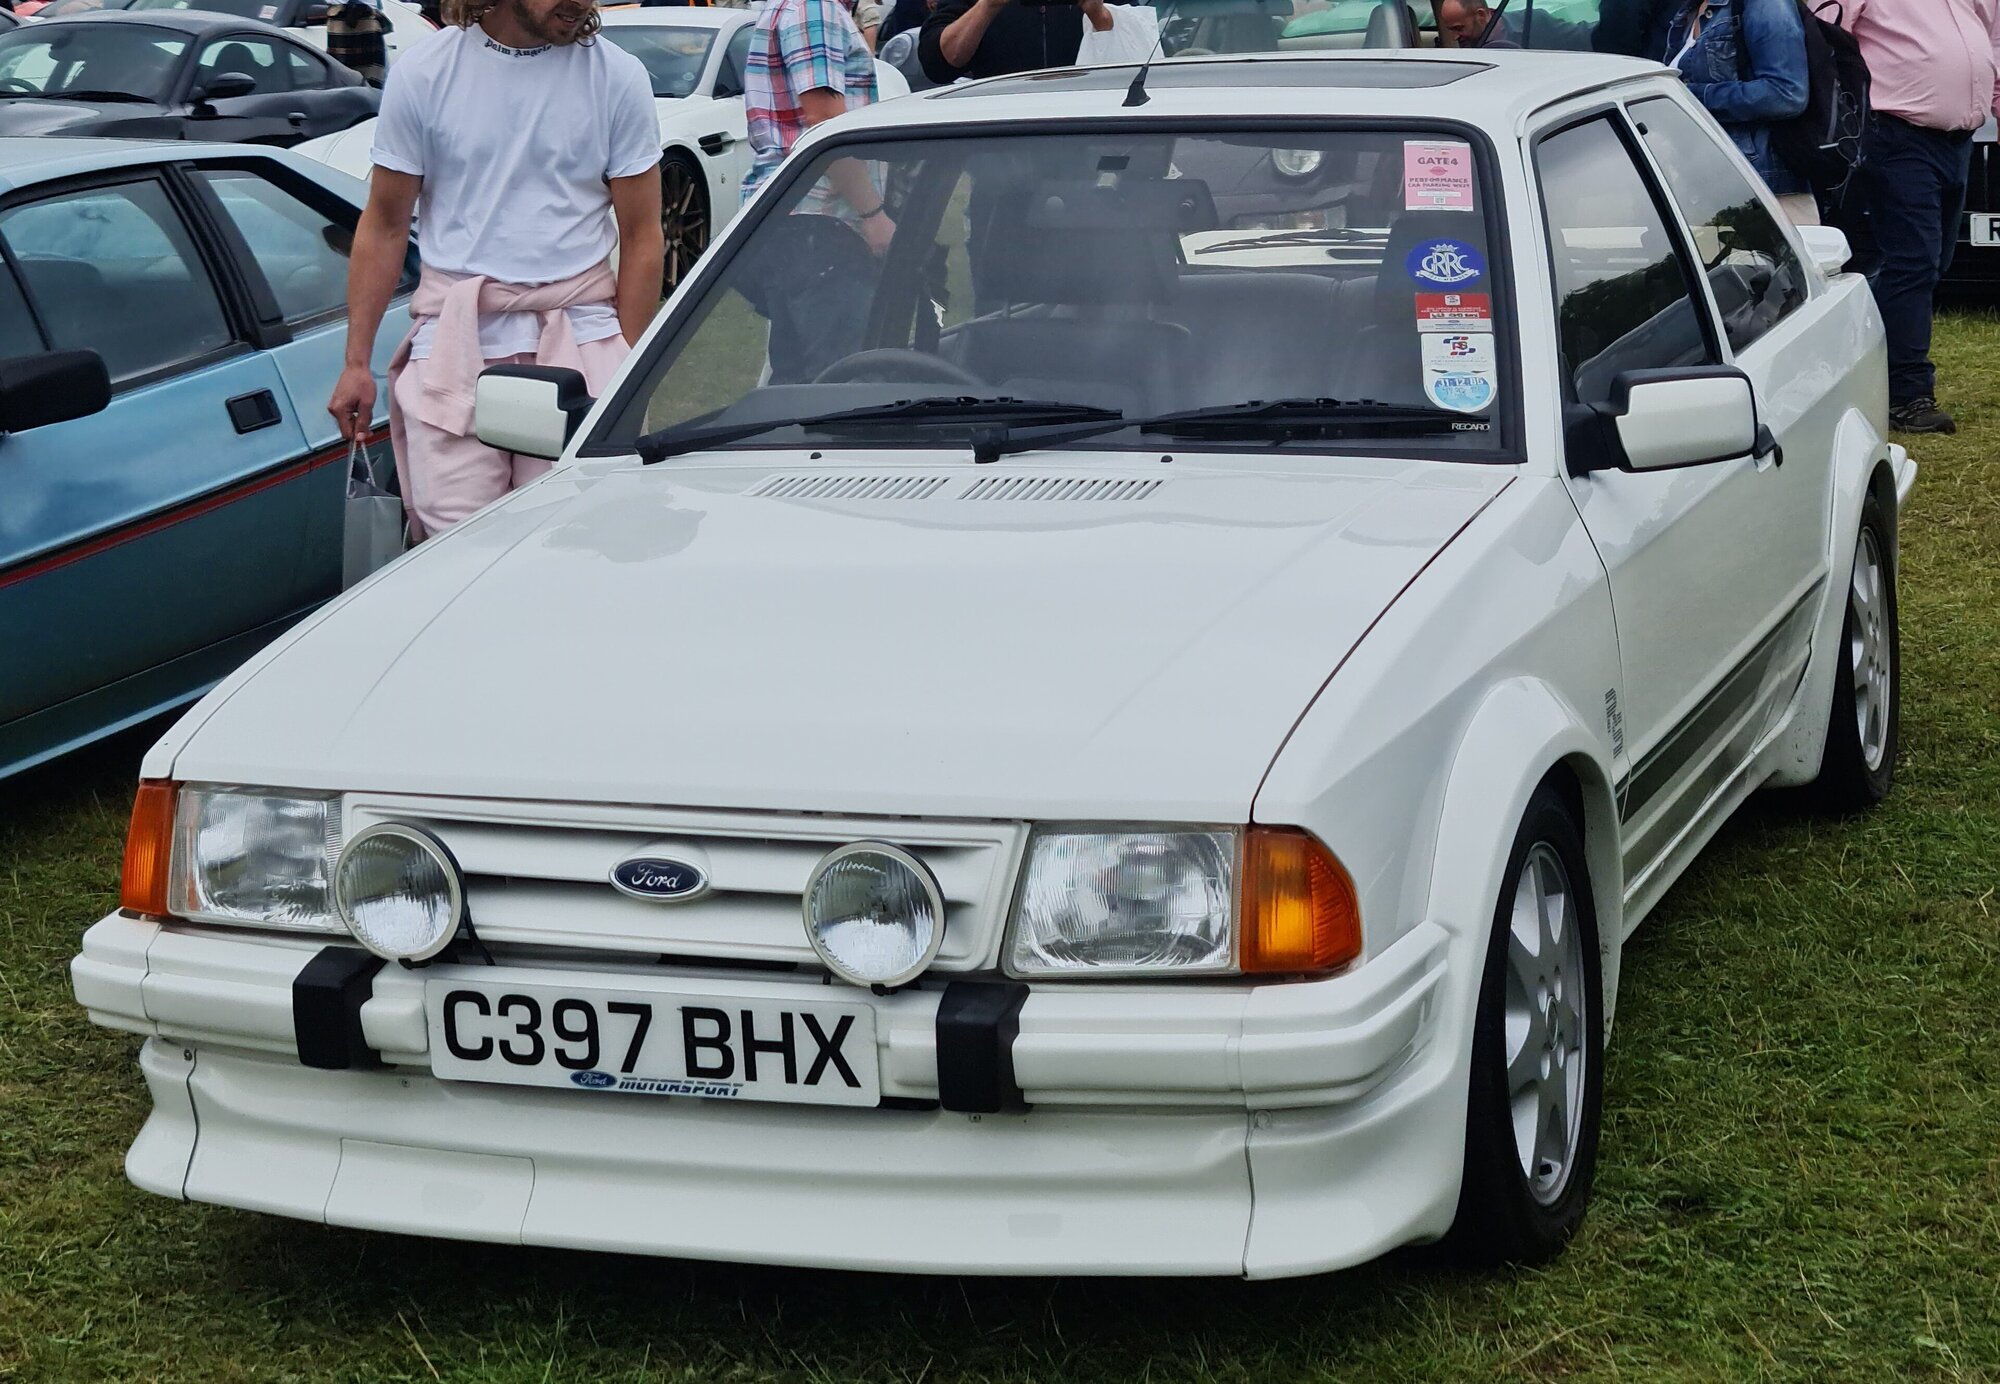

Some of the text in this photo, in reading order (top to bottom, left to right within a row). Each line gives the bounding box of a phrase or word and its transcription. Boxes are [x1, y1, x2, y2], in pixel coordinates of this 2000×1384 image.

[484, 38, 511, 55] Palm
[1421, 252, 1470, 277] GRRC
[1451, 422, 1490, 431] RECARO
[631, 862, 682, 888] Ford
[442, 989, 862, 1088] C397 BHX
[618, 1077, 744, 1096] MOTORSPORT
